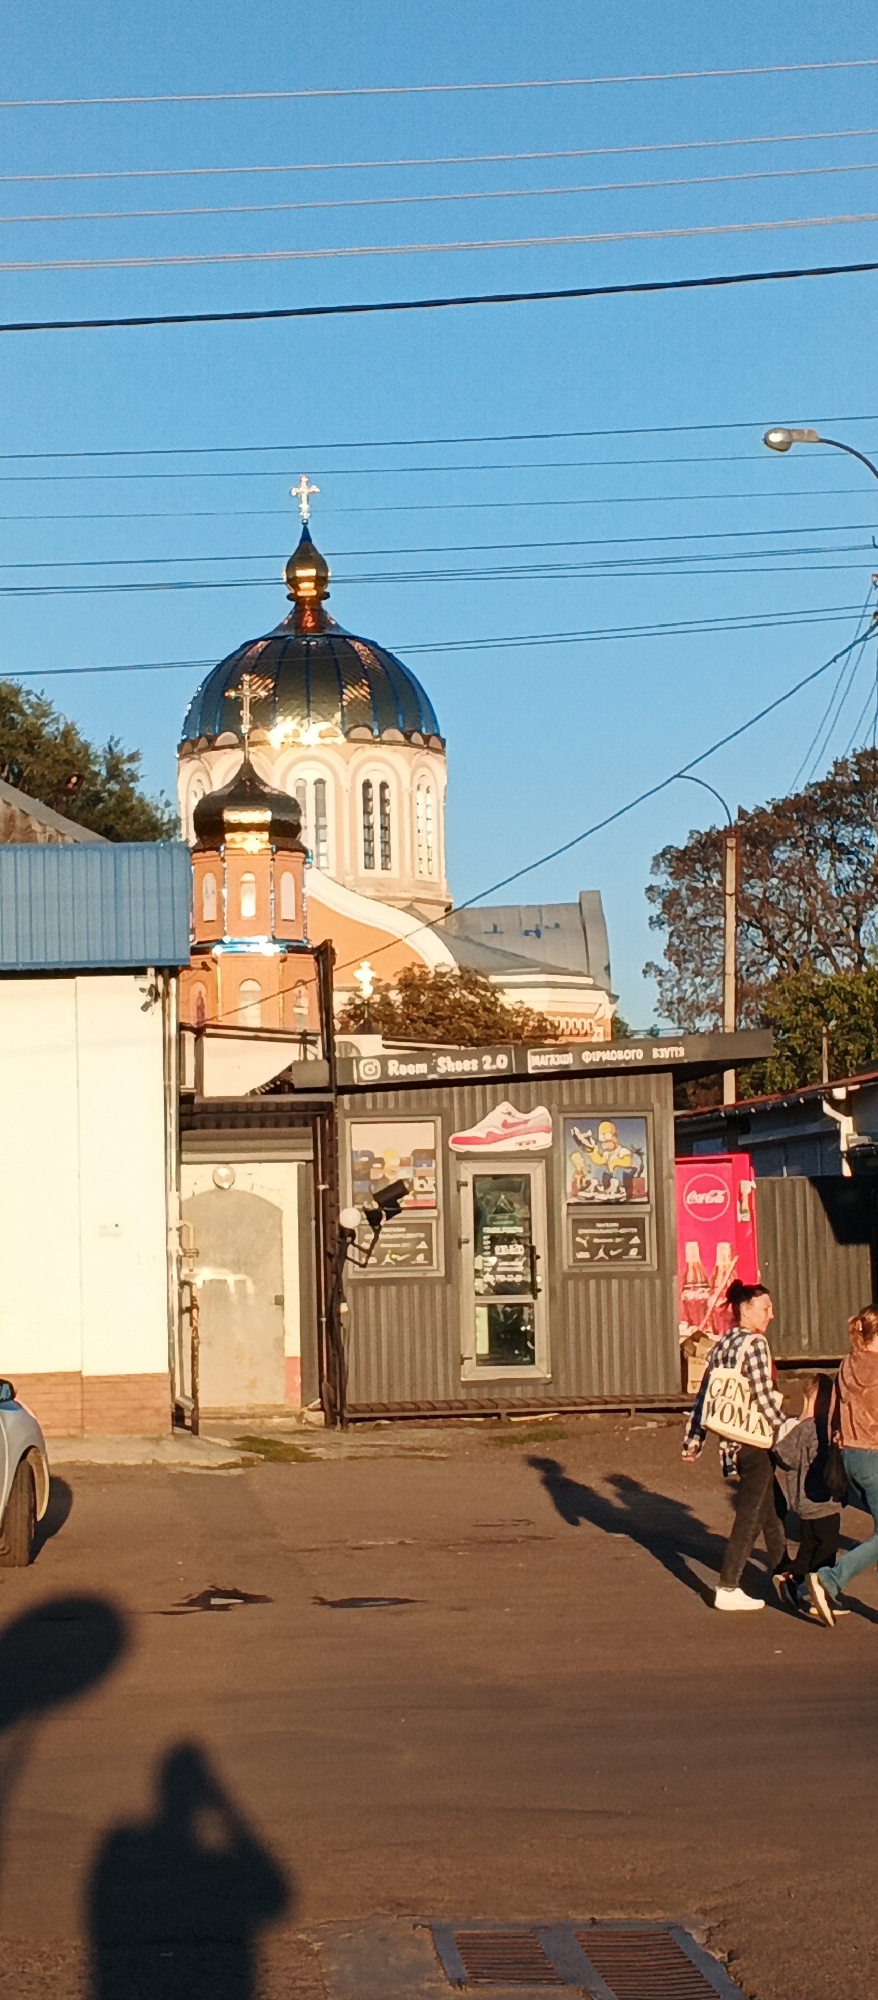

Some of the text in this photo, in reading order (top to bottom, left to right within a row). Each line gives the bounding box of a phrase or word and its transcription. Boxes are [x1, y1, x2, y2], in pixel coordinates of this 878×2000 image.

[482, 1054, 508, 1070] 2.0
[530, 1047, 685, 1067] МАГАЗИН ФІРМОВОГО ВЗУТТЯ
